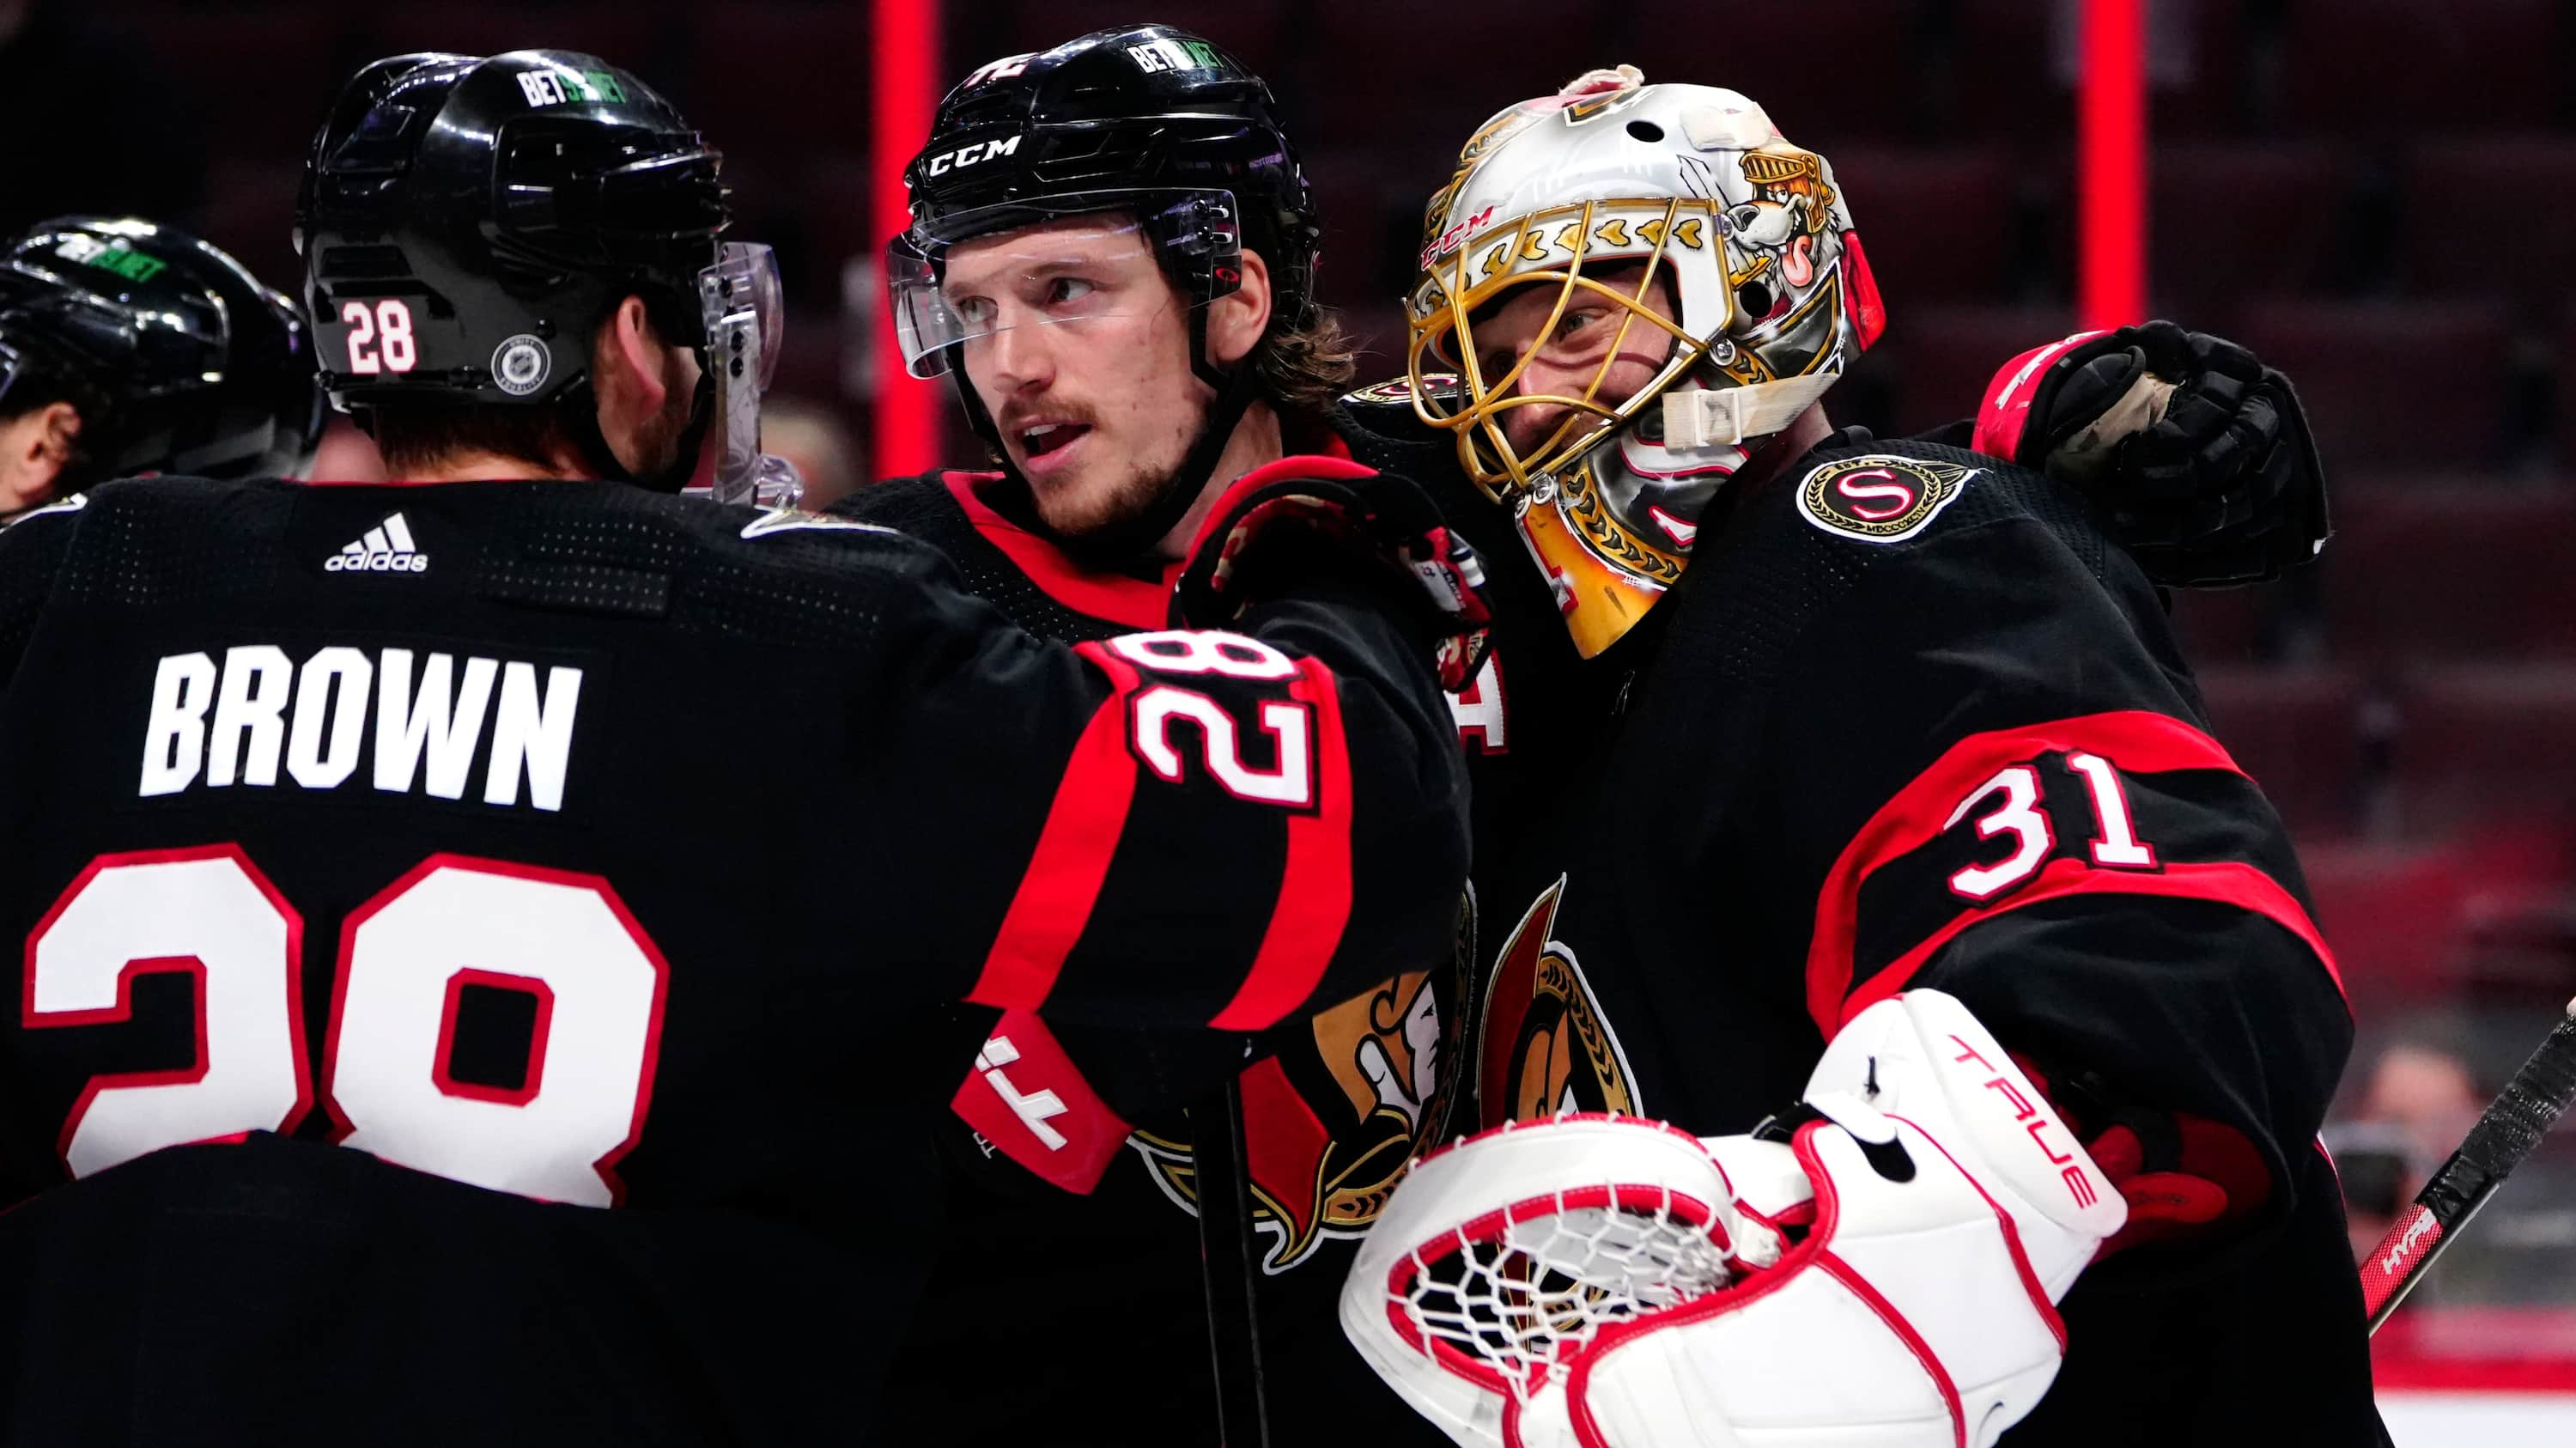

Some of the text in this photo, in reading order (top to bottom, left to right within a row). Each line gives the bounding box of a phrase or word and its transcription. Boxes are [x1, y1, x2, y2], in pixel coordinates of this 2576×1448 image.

[929, 135, 1023, 177] CCM
[1421, 205, 1495, 271] CCM
[342, 299, 417, 374] 28
[325, 549, 428, 572] adidas
[139, 645, 583, 812] BROWN
[1107, 630, 1315, 808] 28
[1940, 750, 2158, 902] 31
[21, 842, 670, 1209] 28
[1947, 1033, 2098, 1209] TRUE
